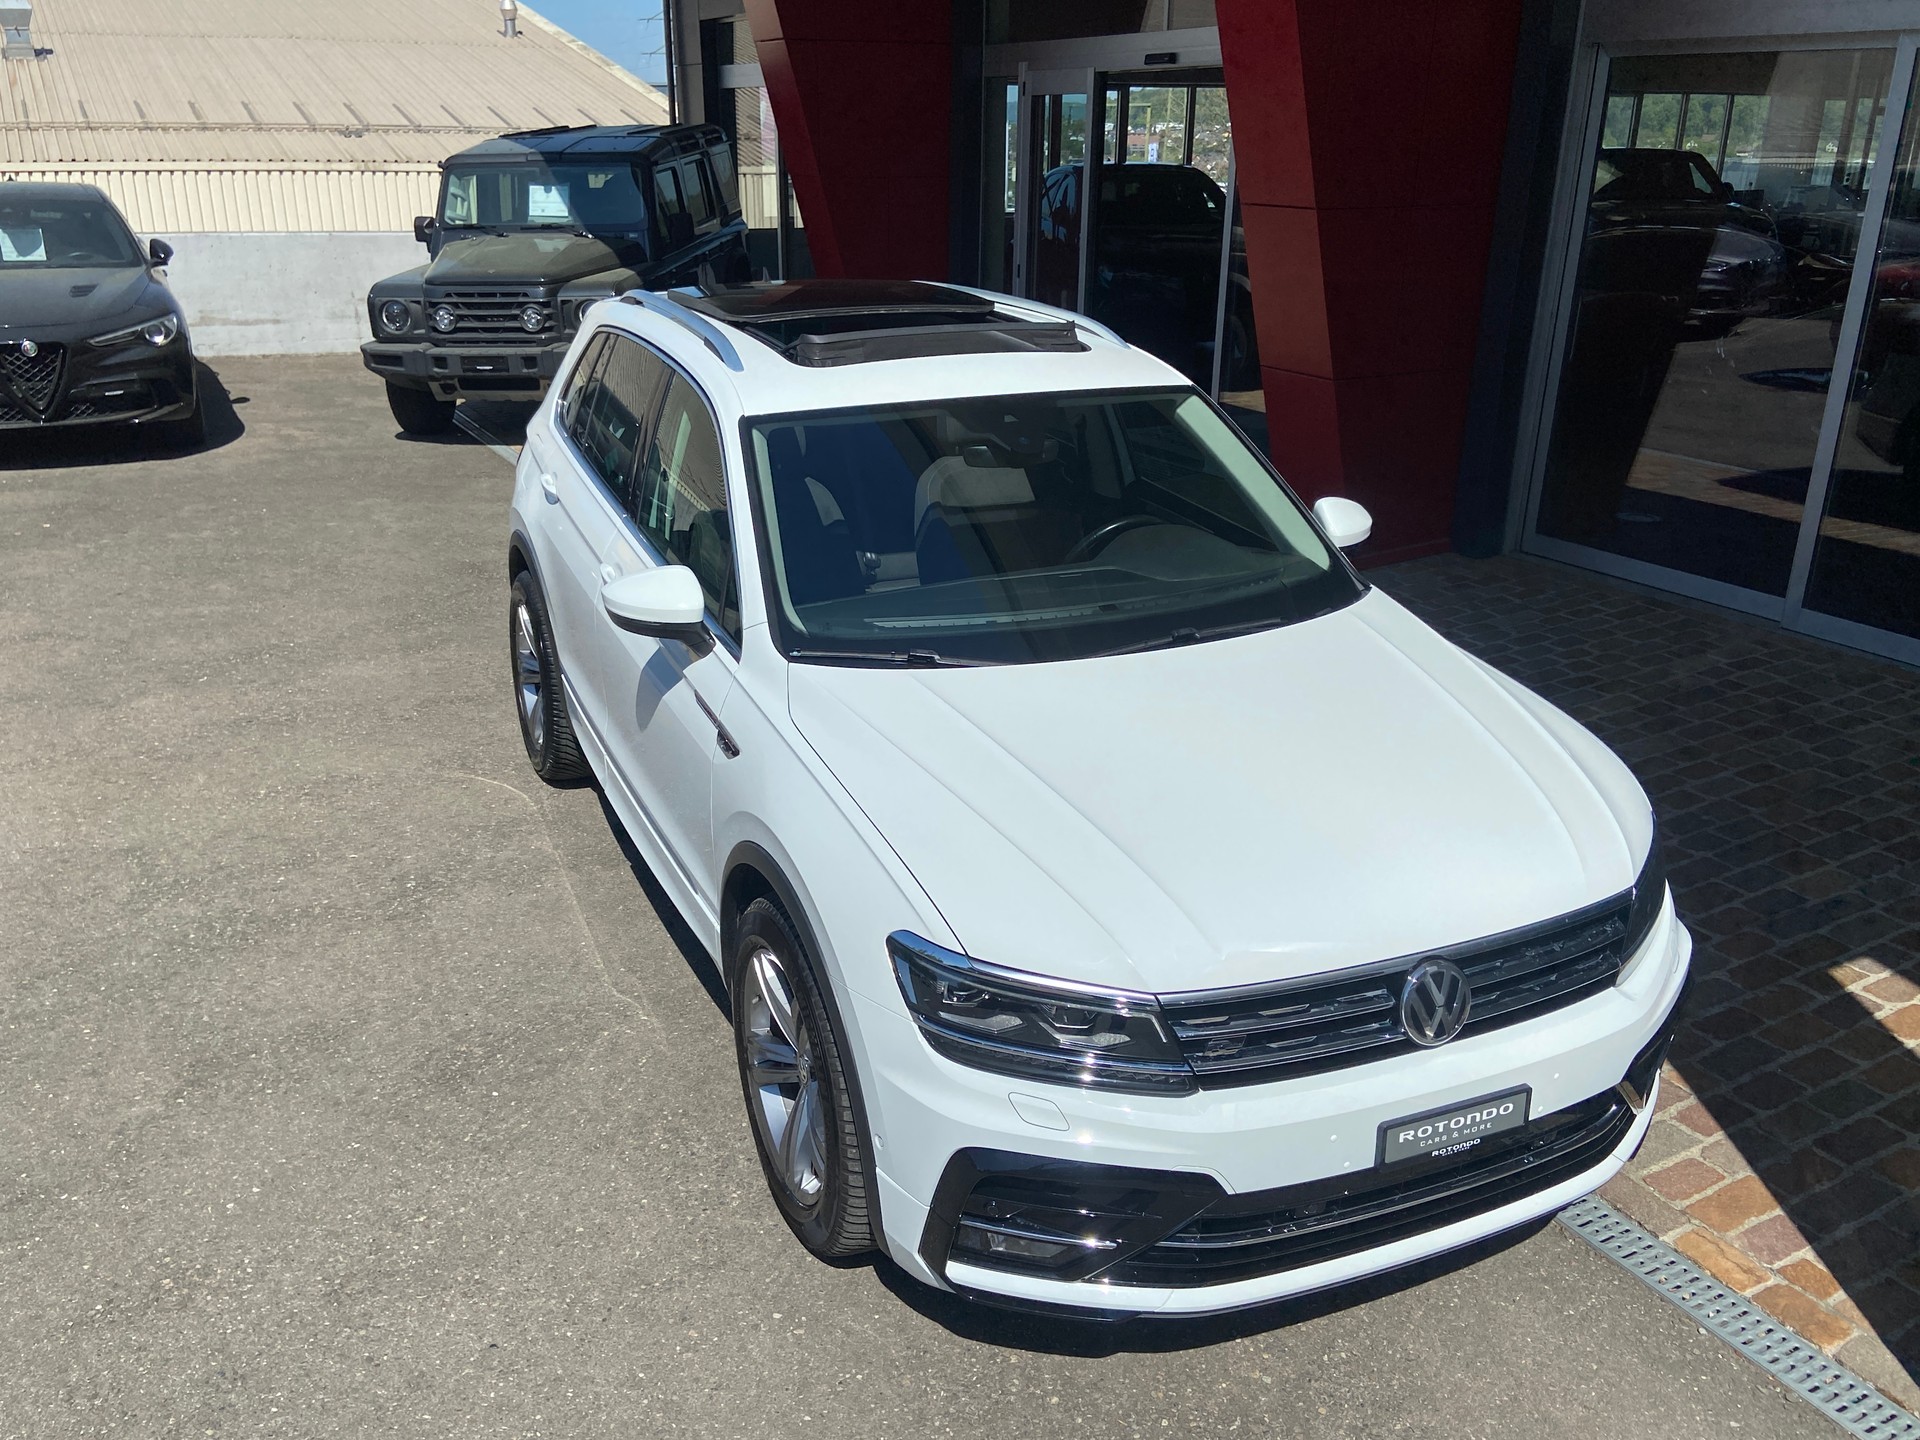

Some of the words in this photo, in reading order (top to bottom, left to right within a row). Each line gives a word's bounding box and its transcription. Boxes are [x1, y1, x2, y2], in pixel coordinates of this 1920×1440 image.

[1399, 1103, 1514, 1143] ROTONDO
[1420, 1135, 1447, 1147] CARS
[1464, 1122, 1493, 1135] MORE
[1431, 1138, 1481, 1157] ROTONDO
